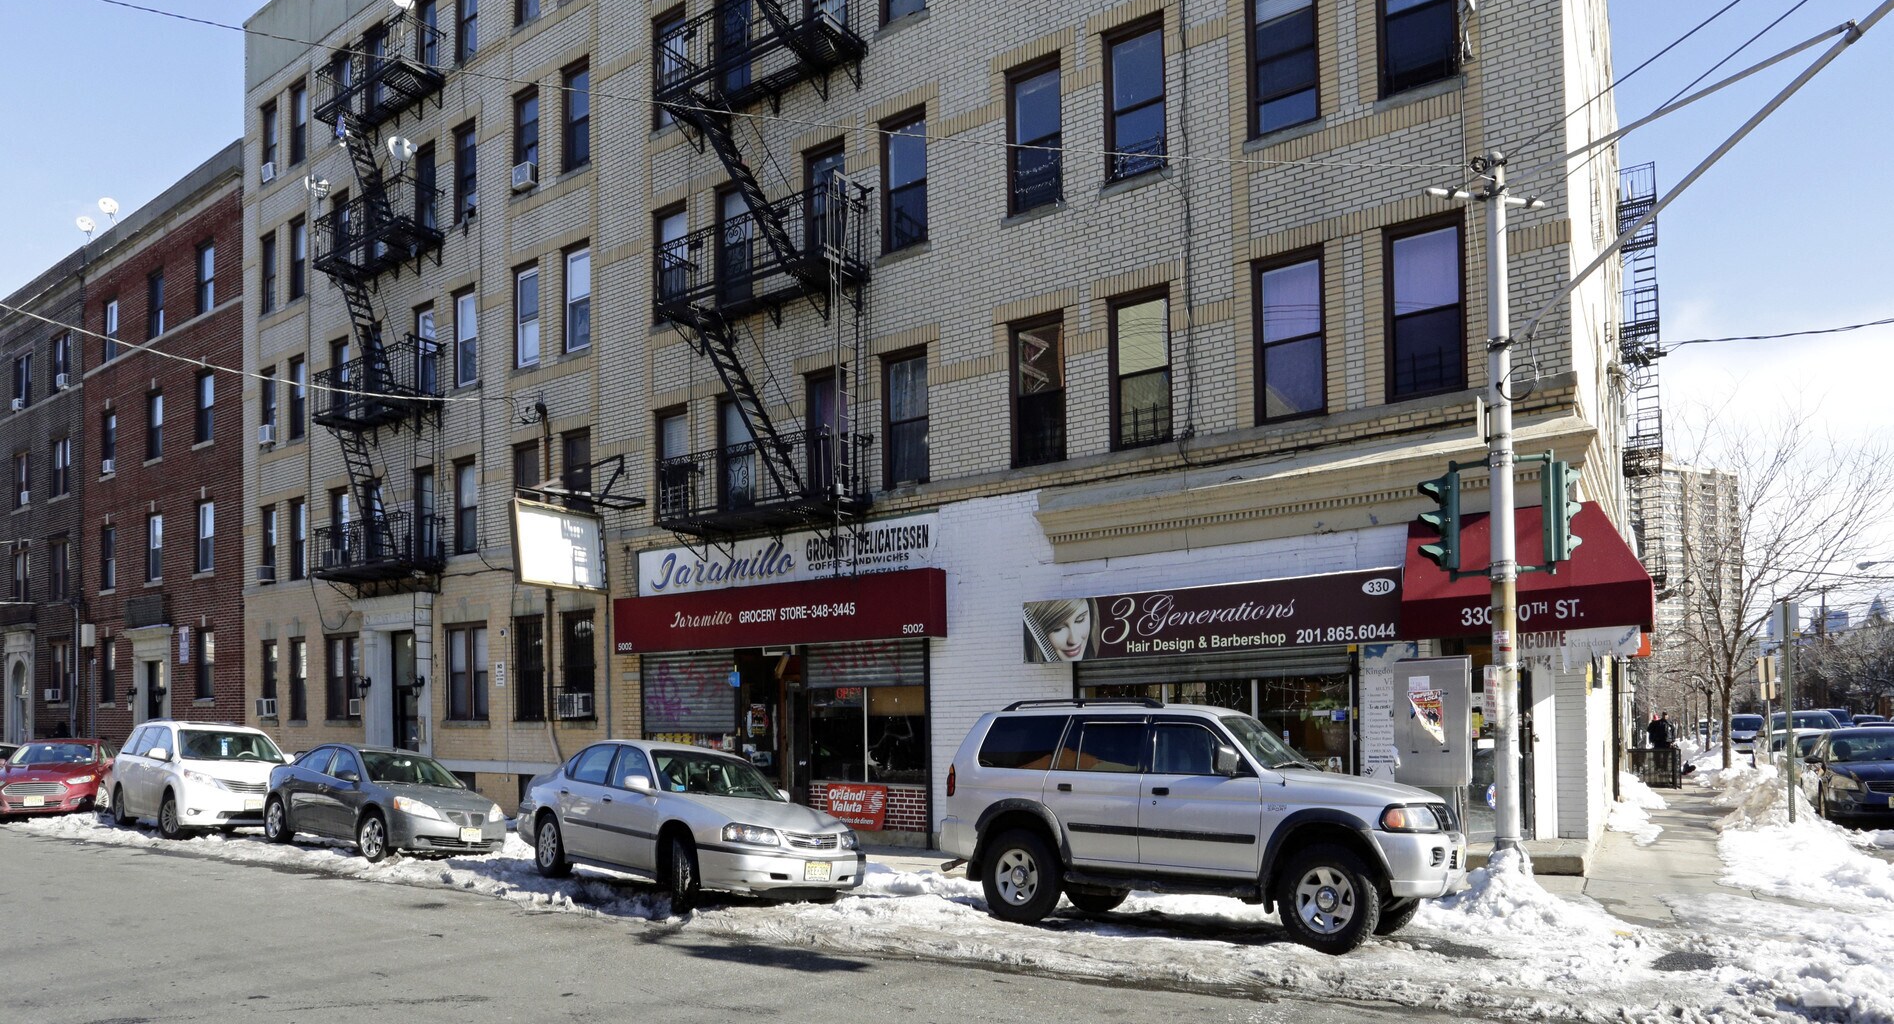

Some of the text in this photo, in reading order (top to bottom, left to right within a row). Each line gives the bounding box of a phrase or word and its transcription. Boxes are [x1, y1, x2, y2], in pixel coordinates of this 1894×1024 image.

[806, 533, 851, 562] GROCRY
[651, 542, 796, 591] Jaramillo
[808, 552, 910, 571] COFFEE SANDWICHES
[1368, 580, 1390, 593] 330
[670, 610, 733, 628] Jaramillo
[738, 608, 777, 624] GROCERY
[1101, 593, 1296, 645] 3 Generations
[1516, 601, 1548, 622] 0TH
[1555, 598, 1584, 619] ST.
[902, 623, 924, 634] 5002
[1296, 622, 1396, 644] 201.865.6044
[617, 642, 633, 651] 5002
[1126, 631, 1287, 653] Hair Design & Barbershop
[1516, 630, 1566, 649] NCOME
[829, 788, 867, 801] Orlandi
[832, 801, 862, 813] Valuta
